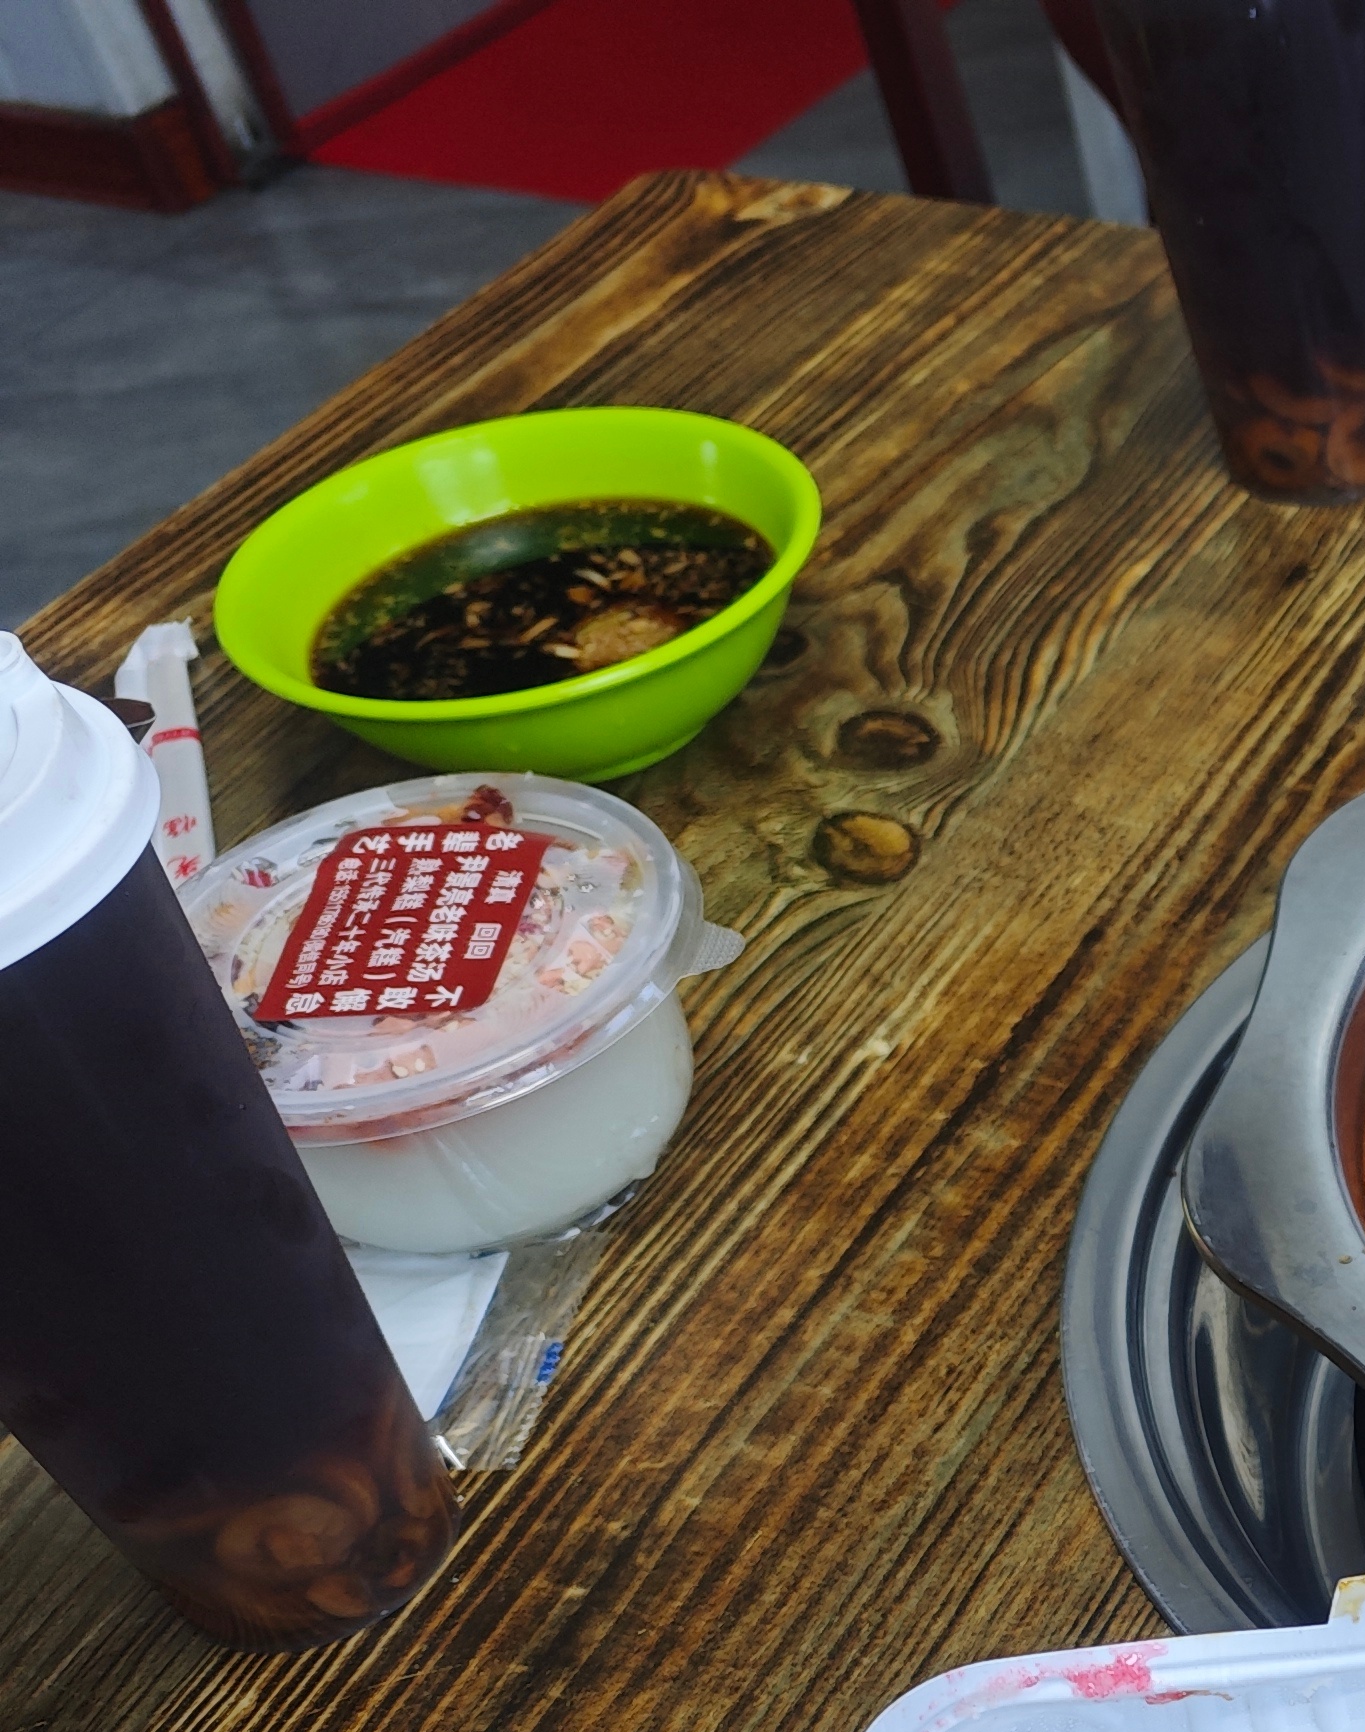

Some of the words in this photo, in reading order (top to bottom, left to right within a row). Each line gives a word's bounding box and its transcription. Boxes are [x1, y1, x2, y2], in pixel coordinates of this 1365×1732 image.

[484, 870, 523, 904] 清真
[318, 857, 397, 986] 三代传承二十年小店
[463, 922, 502, 960] 回回
[285, 986, 464, 1015] 不敢懈怠
